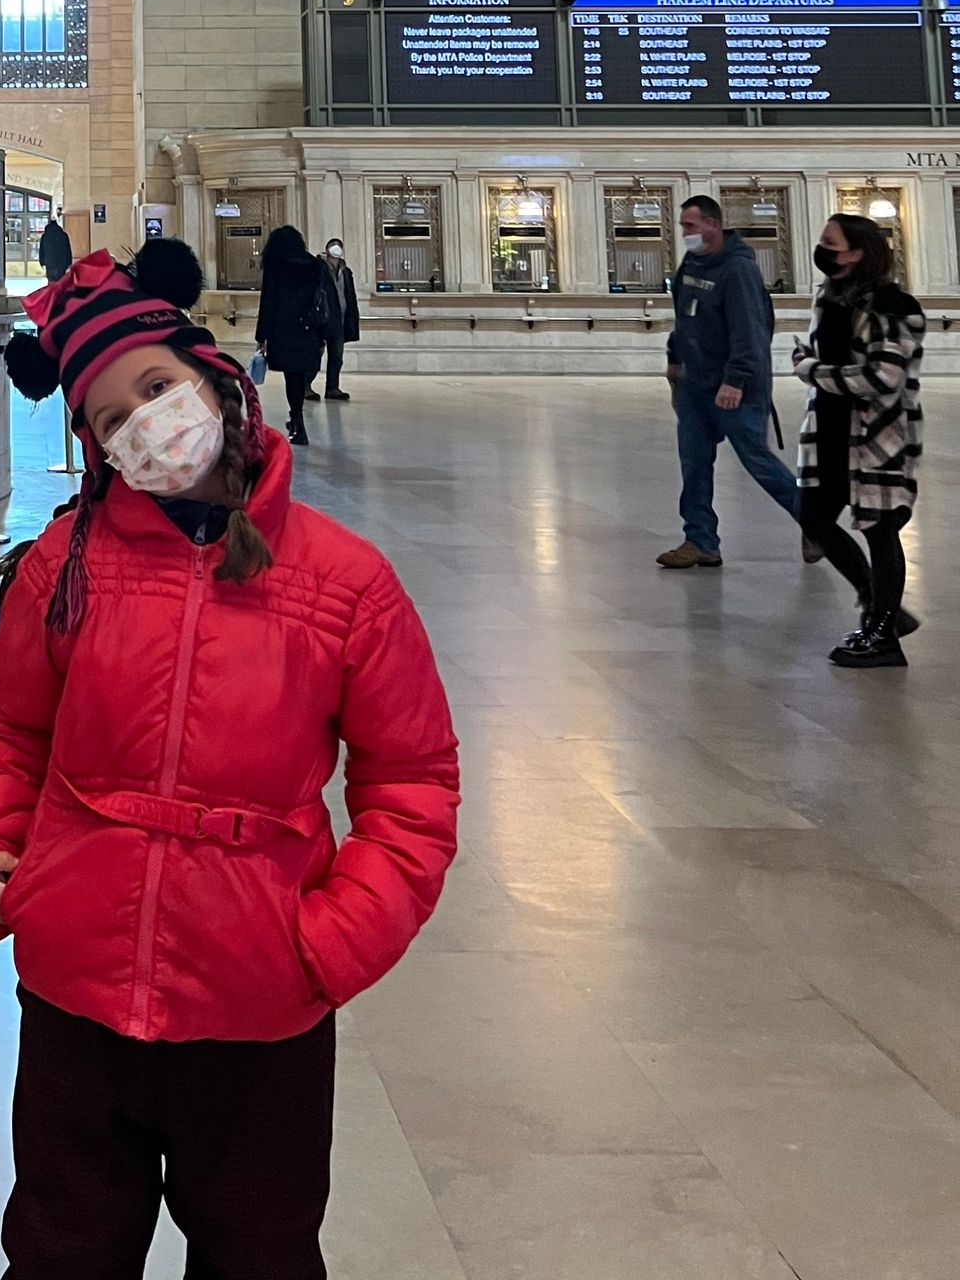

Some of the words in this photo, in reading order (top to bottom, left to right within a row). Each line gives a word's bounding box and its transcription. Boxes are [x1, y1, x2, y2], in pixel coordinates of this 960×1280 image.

[428, 14, 464, 24] Attention
[465, 14, 512, 24] Customers:
[637, 14, 703, 23] DESTINATION
[404, 27, 428, 36] Never
[429, 27, 451, 36] leave
[452, 27, 490, 37] packages
[492, 27, 537, 36] unattended
[638, 28, 688, 36] SOUTHEAST
[402, 40, 448, 48] Unattended
[473, 42, 490, 50] may
[492, 40, 502, 48] be
[504, 40, 539, 48] removed
[640, 40, 689, 48] SOUTHEAST
[803, 40, 826, 48] STOP
[423, 53, 436, 61] the
[438, 53, 457, 61] MTA
[458, 53, 483, 61] Police
[485, 53, 532, 63] Department
[410, 66, 436, 74] Thank
[437, 67, 452, 76] you
[454, 66, 465, 74] for
[466, 67, 484, 76] your
[485, 66, 533, 76] cooperation
[640, 66, 690, 74] SOUTHEAST
[642, 92, 692, 100] SOUTHEAST
[18, 134, 44, 148] HALL
[906, 153, 948, 166] MTA
